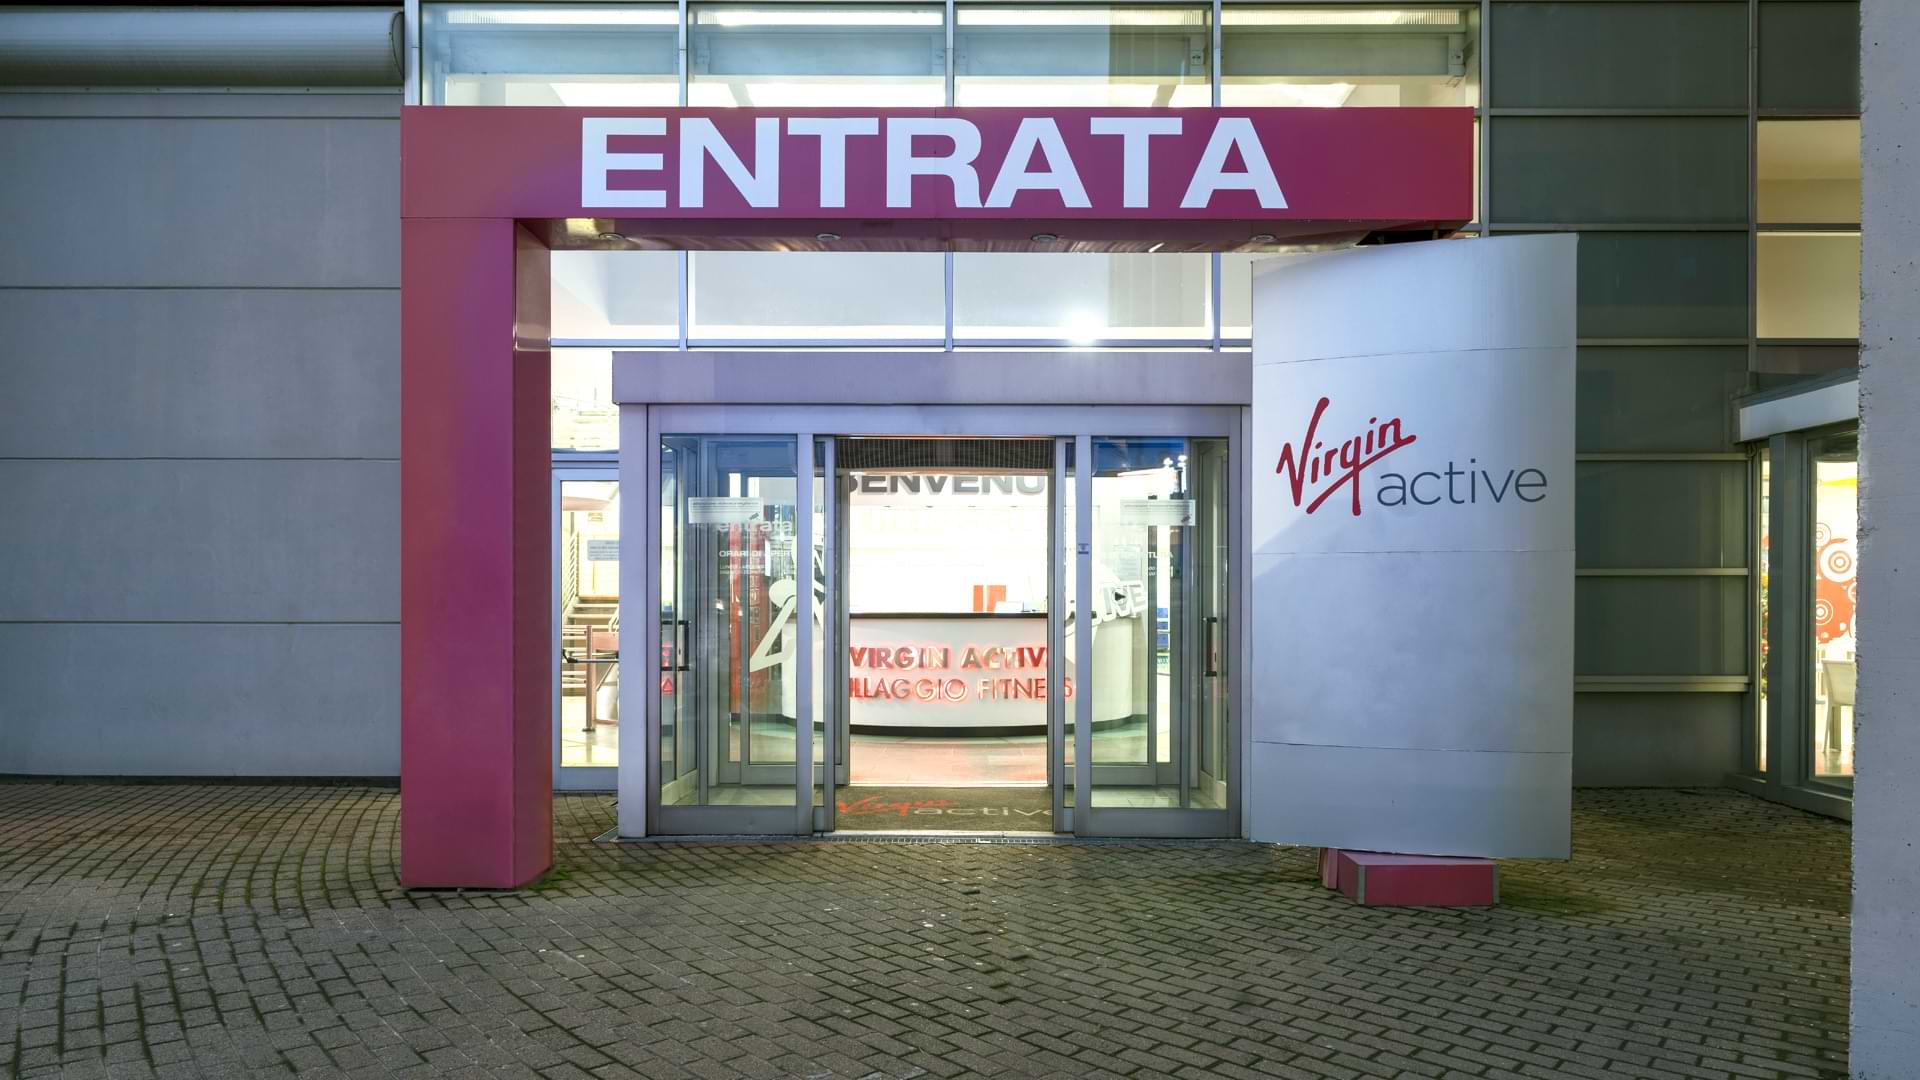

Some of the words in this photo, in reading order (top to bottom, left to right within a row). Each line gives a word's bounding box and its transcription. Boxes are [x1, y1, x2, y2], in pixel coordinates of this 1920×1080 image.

[581, 116, 1289, 209] ENTRATA
[1275, 396, 1417, 517] Virgin
[1376, 458, 1548, 507] active
[849, 646, 949, 669] VIRGIN
[961, 647, 1048, 669] ACTIV
